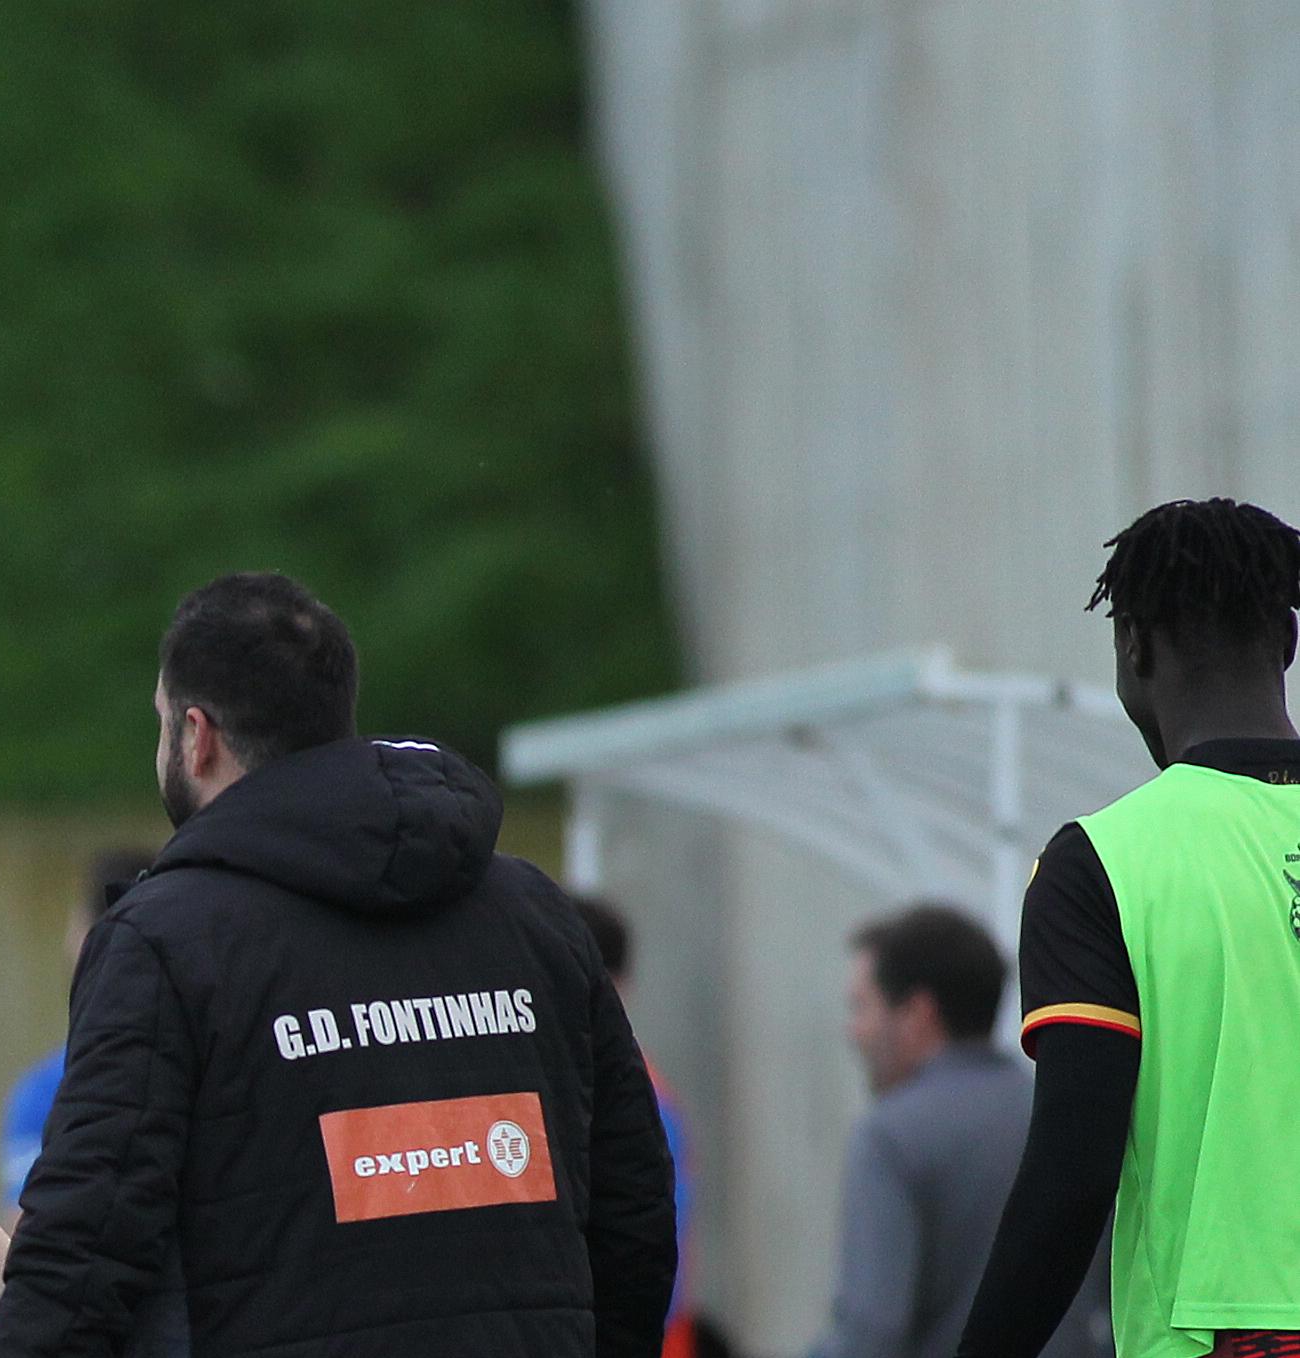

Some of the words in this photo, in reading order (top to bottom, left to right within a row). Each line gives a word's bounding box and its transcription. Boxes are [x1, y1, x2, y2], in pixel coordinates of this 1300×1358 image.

[272, 1008, 352, 1061] G.D.
[351, 988, 537, 1047] FONTINHAS
[353, 1139, 481, 1178] expert
